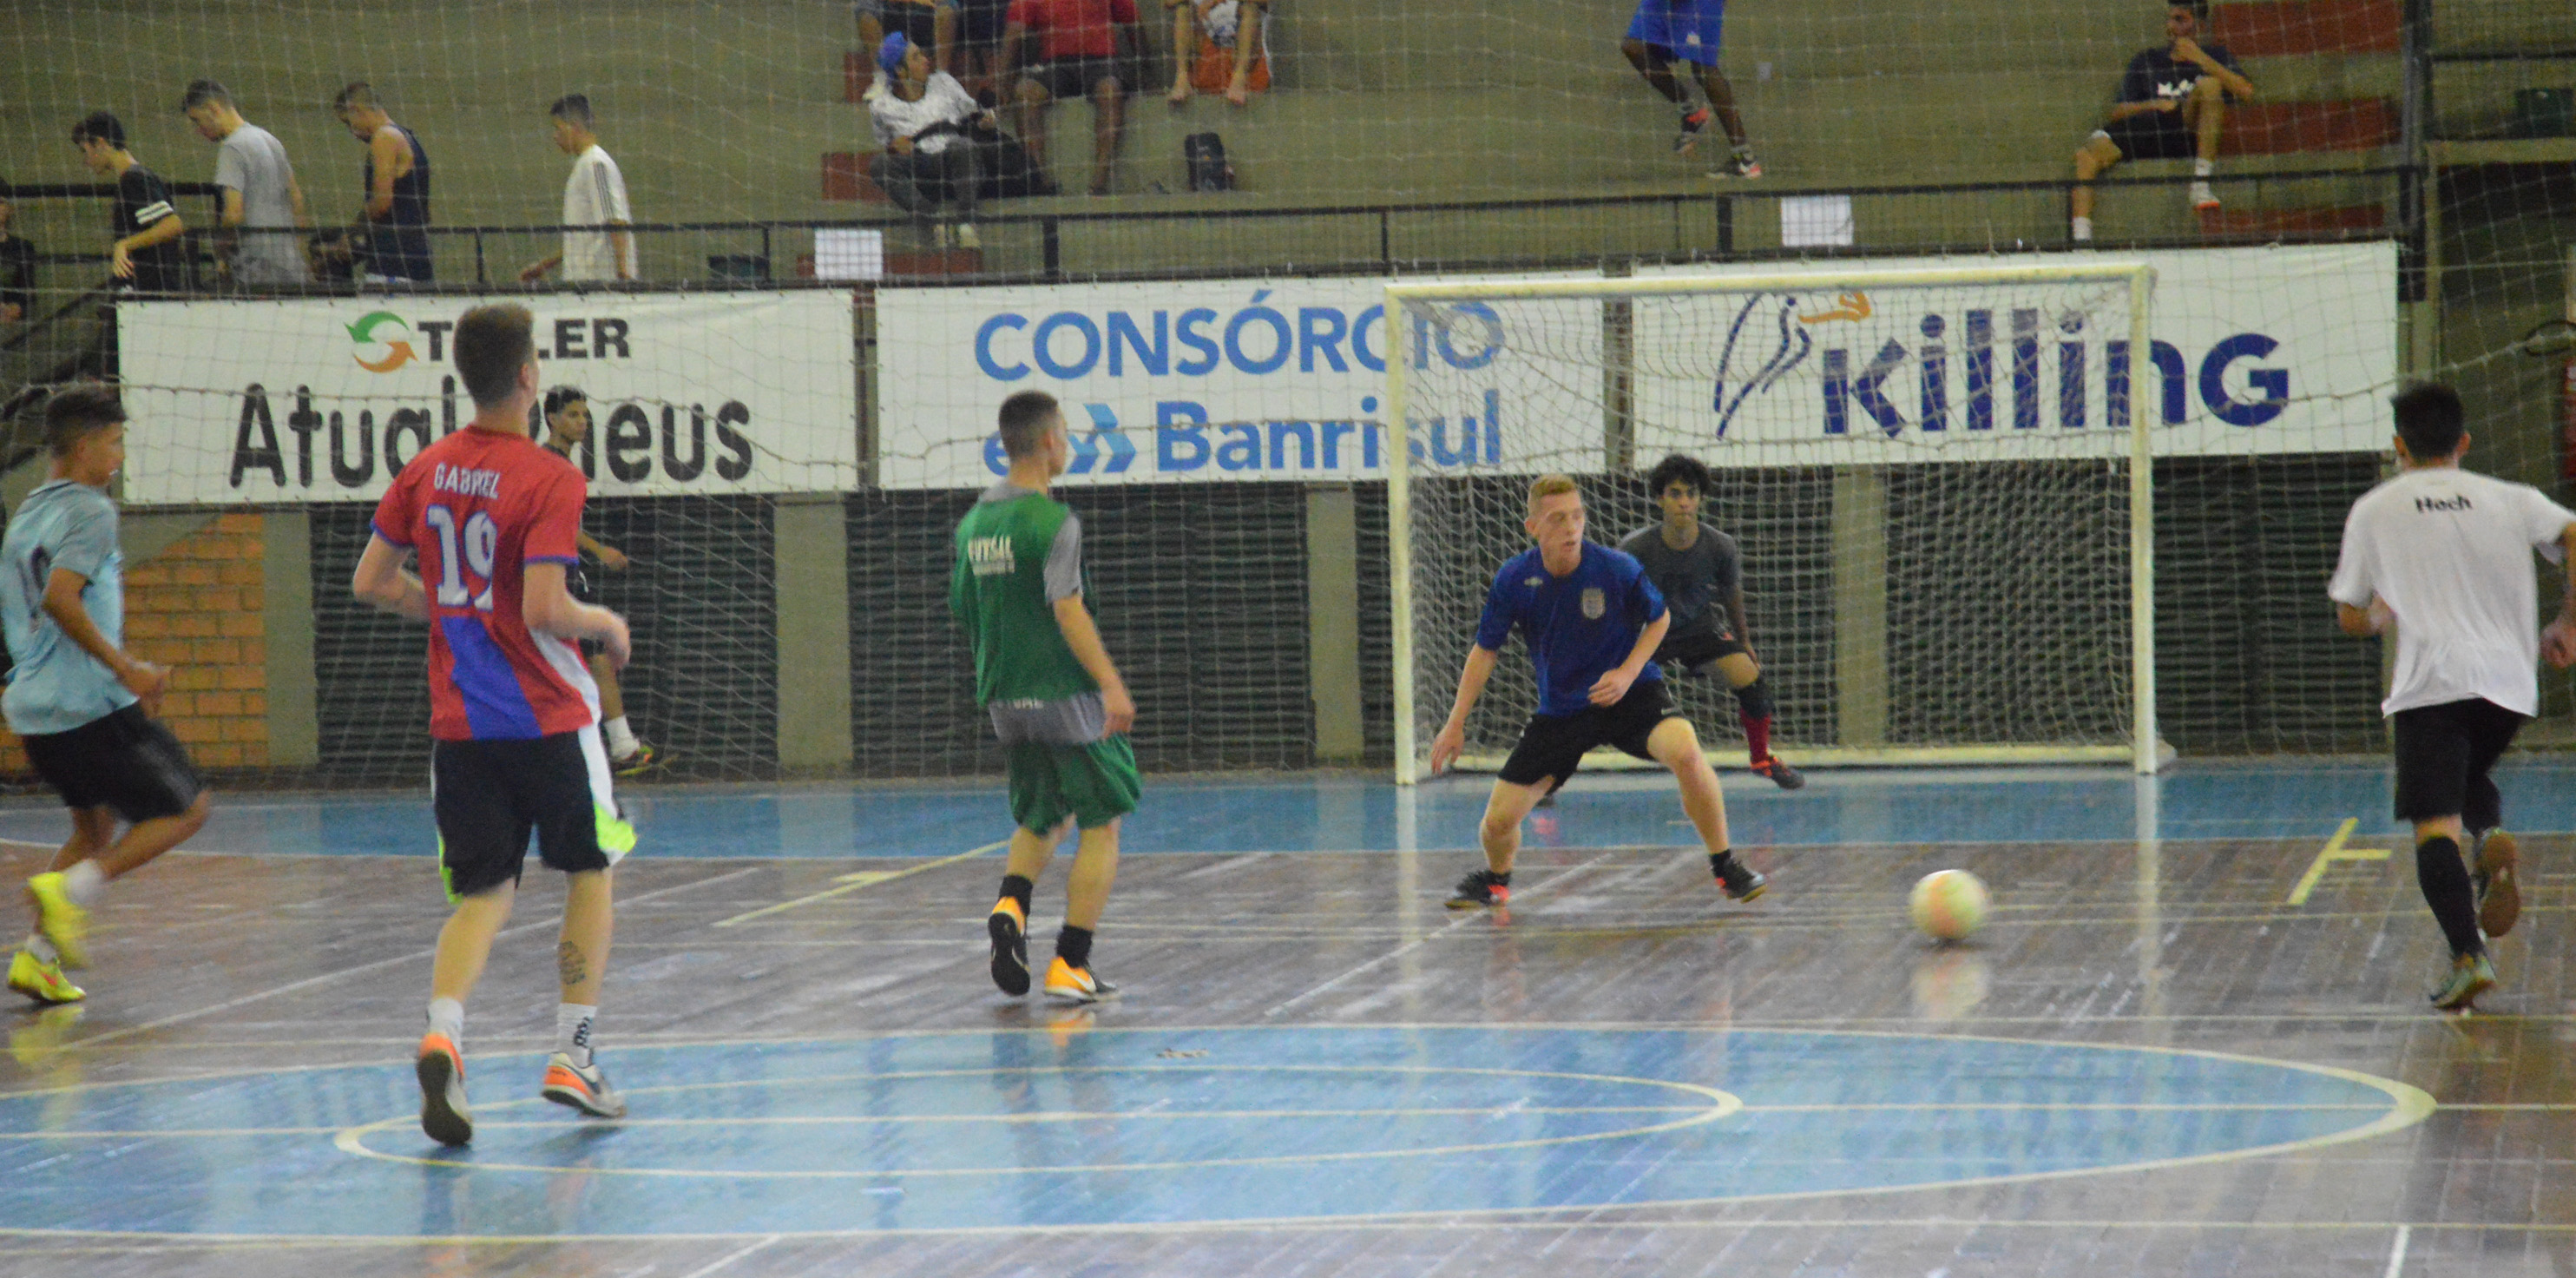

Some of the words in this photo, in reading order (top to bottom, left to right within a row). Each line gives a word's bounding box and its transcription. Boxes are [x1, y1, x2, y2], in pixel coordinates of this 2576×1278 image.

[417, 318, 631, 361] TER
[974, 289, 1506, 382] CONSÓRCIO
[528, 396, 754, 483] eus
[425, 503, 498, 612] 19
